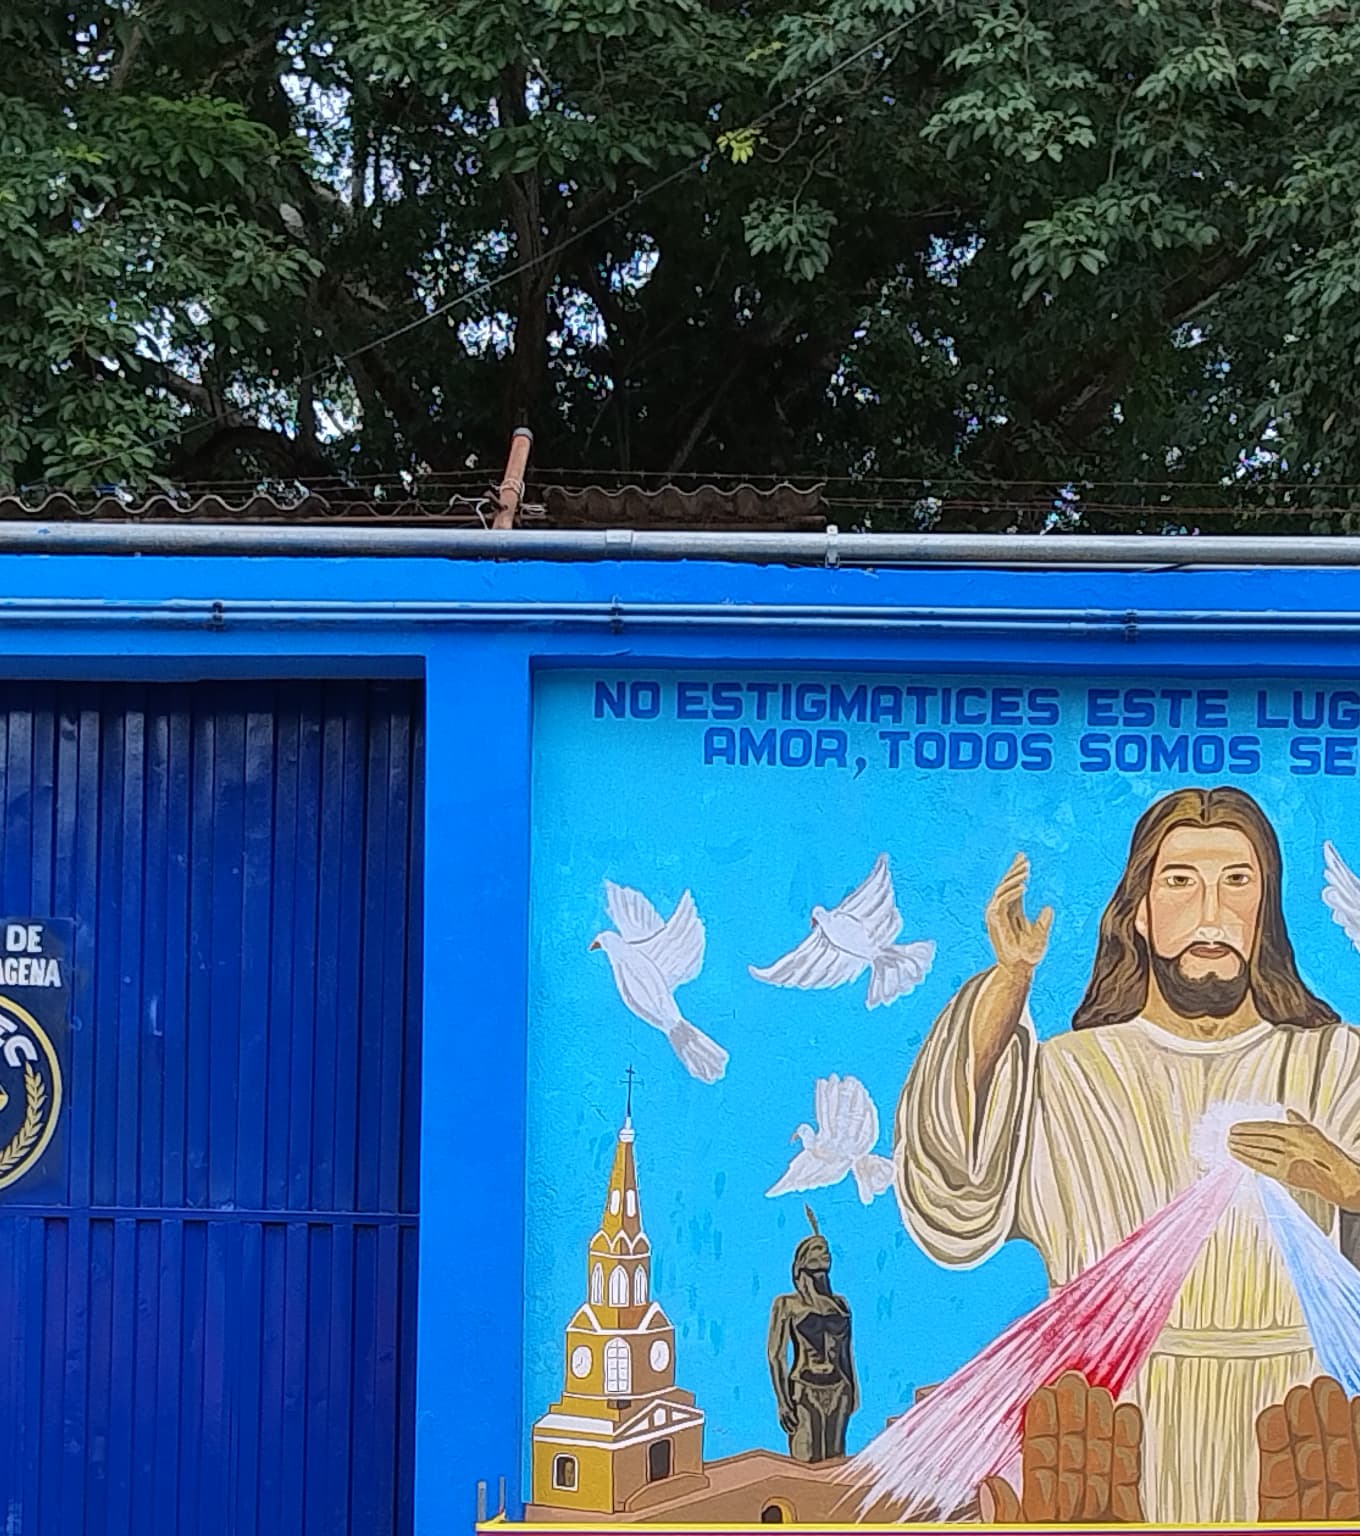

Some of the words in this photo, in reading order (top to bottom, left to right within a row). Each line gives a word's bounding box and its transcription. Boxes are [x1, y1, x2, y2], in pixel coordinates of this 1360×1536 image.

[594, 681, 661, 720] NO
[676, 682, 1060, 726] ESTIGMATICES
[1086, 688, 1229, 729] ESTE
[703, 728, 868, 780] AMOR,
[879, 730, 1053, 771] TODOS
[1079, 734, 1261, 774] SOMOS
[6, 926, 43, 953] DE
